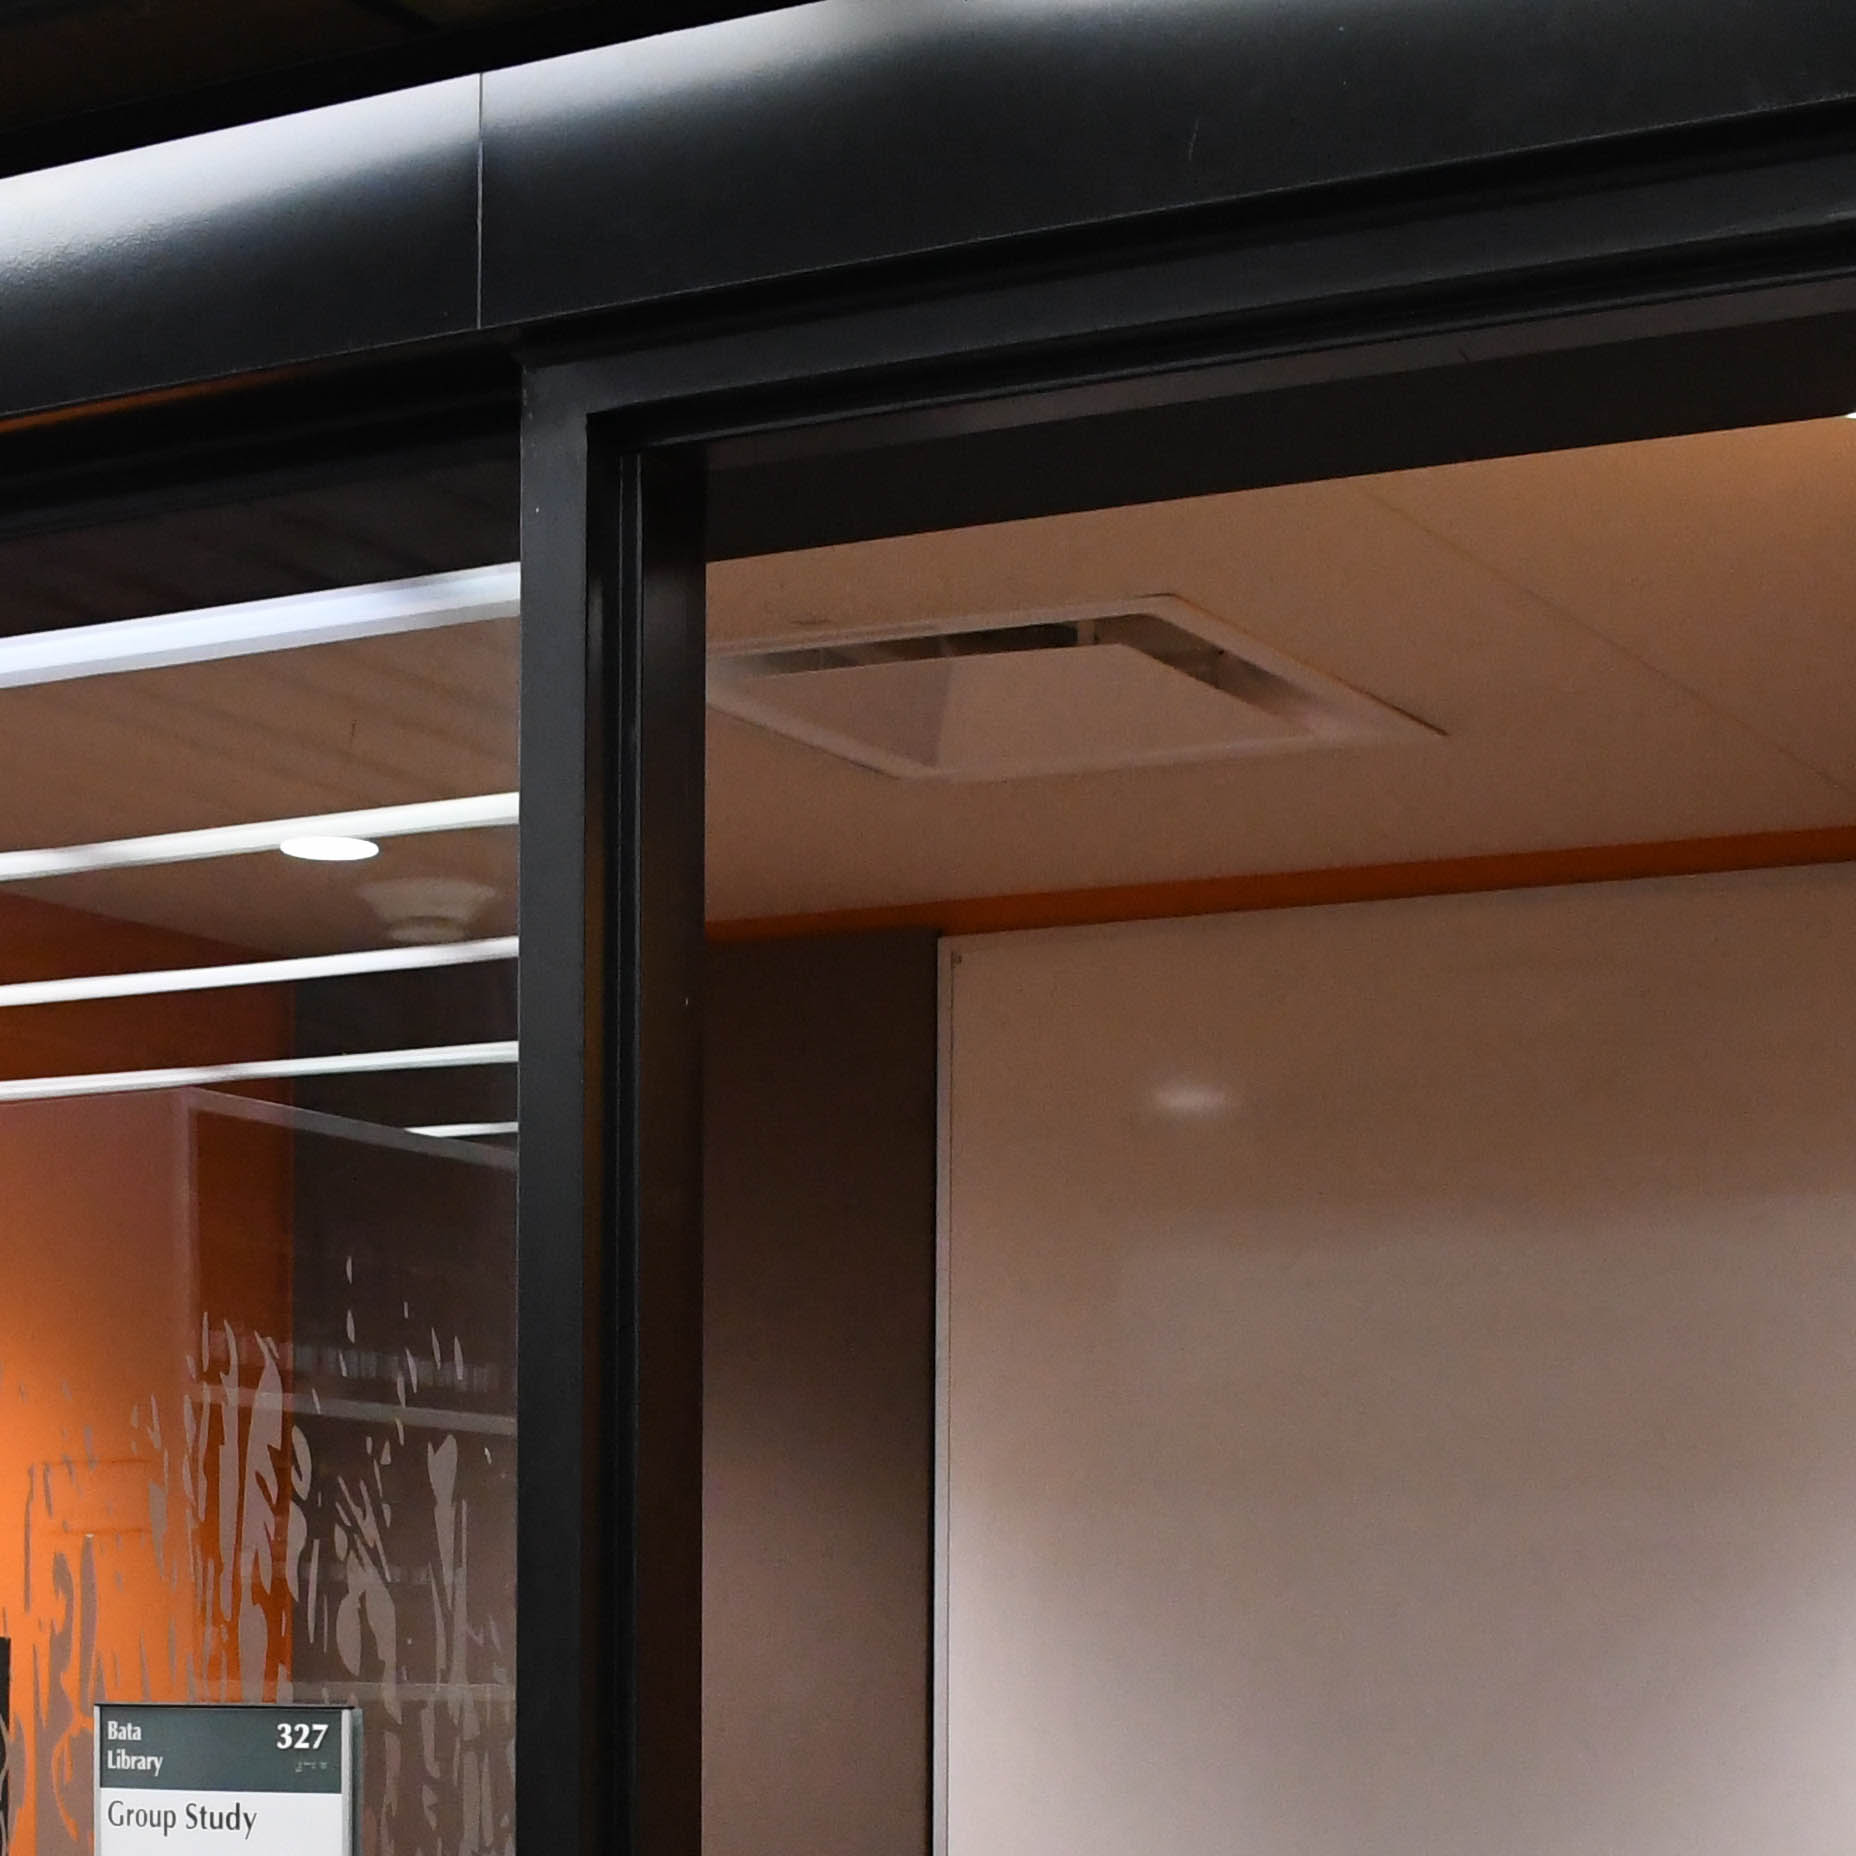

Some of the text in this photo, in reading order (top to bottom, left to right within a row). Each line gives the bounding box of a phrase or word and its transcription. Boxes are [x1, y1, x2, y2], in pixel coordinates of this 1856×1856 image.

[107, 1721, 142, 1741] Bata
[276, 1723, 329, 1749] 327
[107, 1749, 164, 1777] Library
[107, 1800, 257, 1841] Group Study
